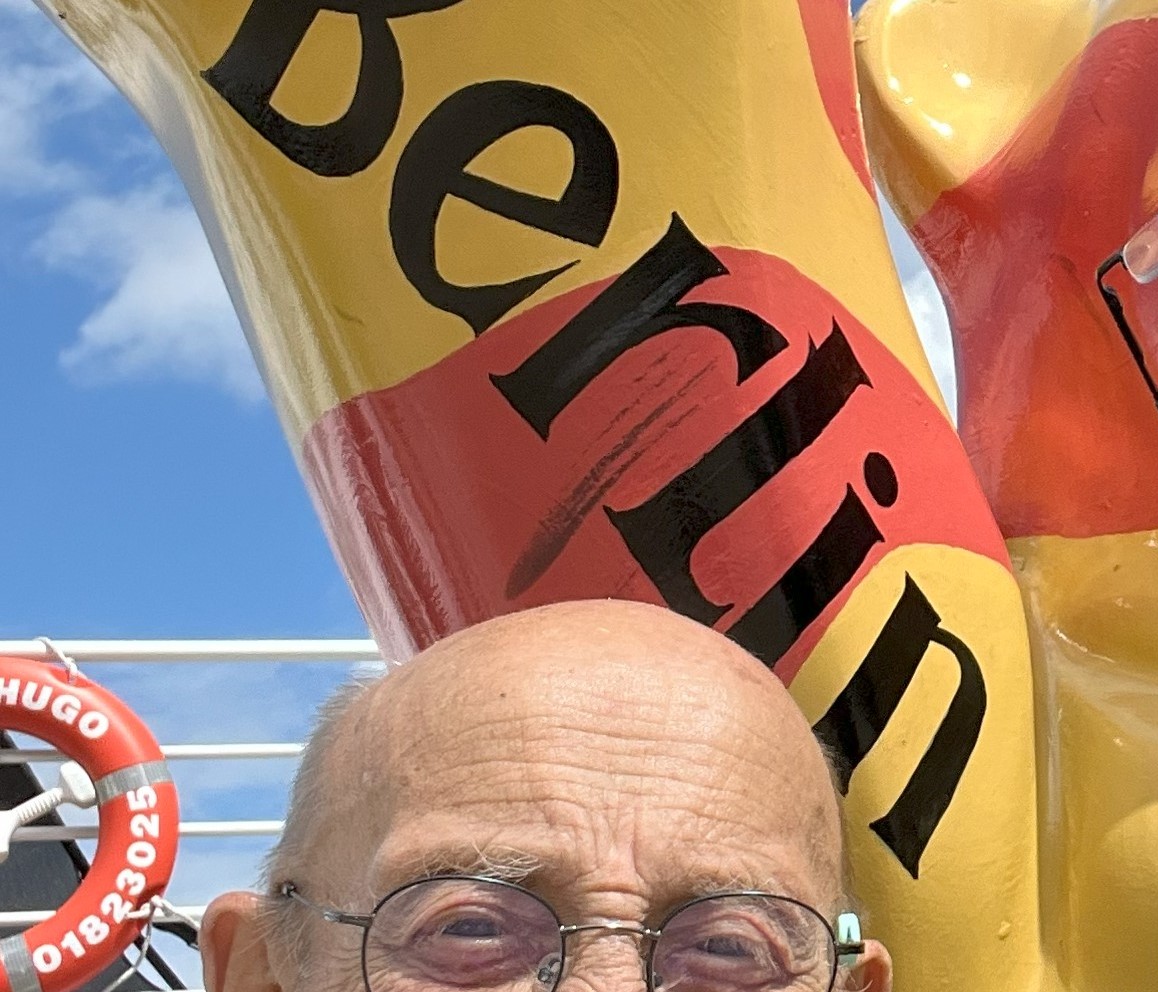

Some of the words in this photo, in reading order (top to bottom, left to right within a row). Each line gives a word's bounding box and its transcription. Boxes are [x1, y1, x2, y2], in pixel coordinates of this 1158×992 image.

[200, 0, 987, 879] Berlin
[0, 677, 109, 739] HUGO
[32, 785, 160, 973] 01823025
